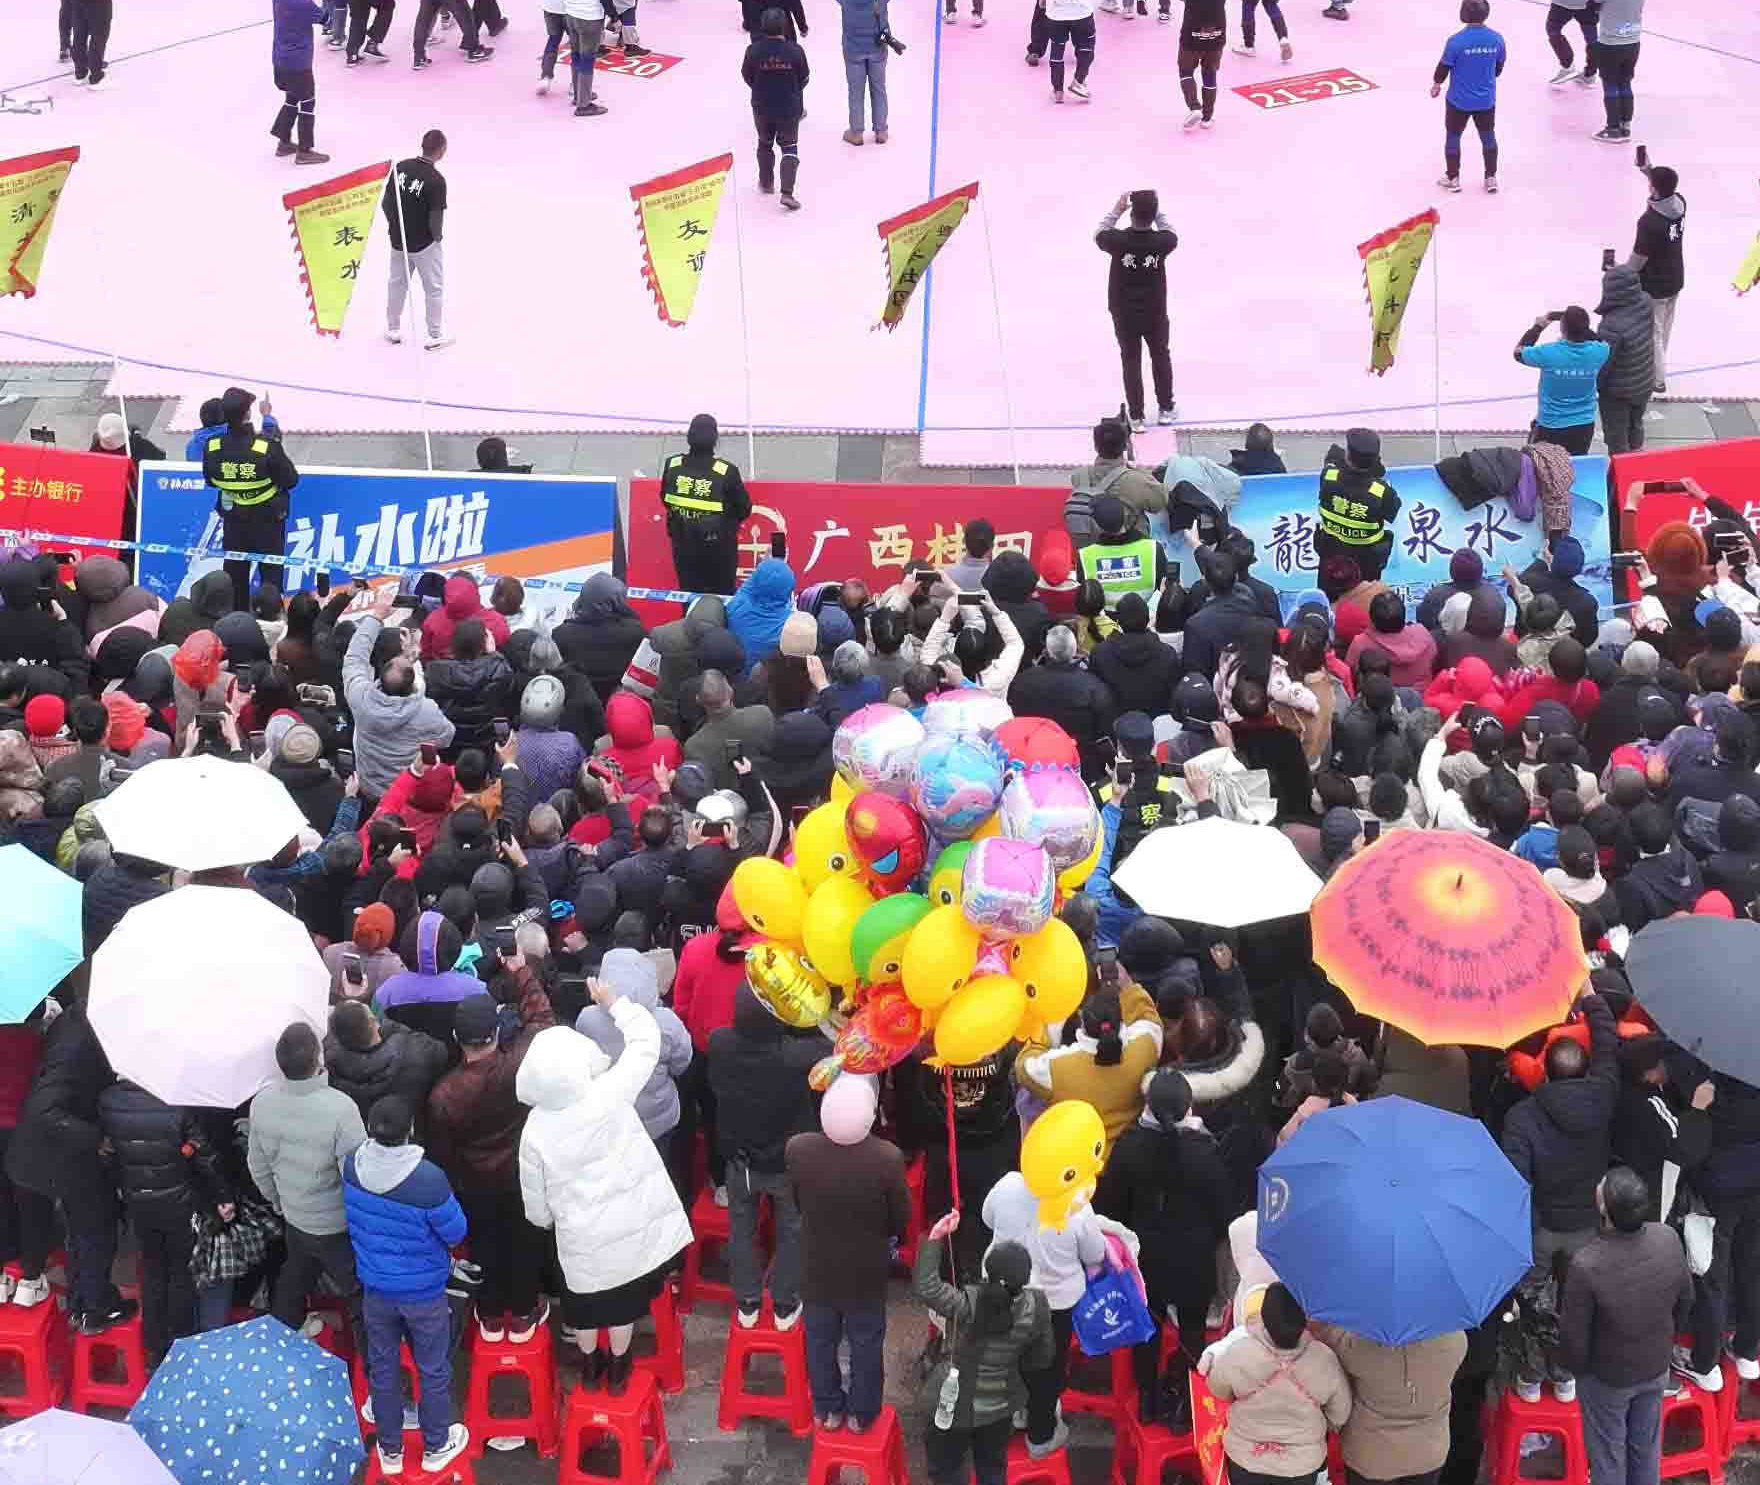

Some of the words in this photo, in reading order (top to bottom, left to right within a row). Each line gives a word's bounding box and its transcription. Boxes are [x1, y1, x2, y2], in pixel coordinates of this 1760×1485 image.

[1121, 253, 1159, 270] 裁判
[221, 461, 257, 480] 警察
[10, 475, 84, 504] 主办银行
[675, 475, 712, 497] 警察
[1332, 496, 1369, 519] 警察
[286, 491, 490, 592] 补水啦
[1264, 502, 1524, 573] 龍泉水
[1141, 803, 1162, 827] 察
